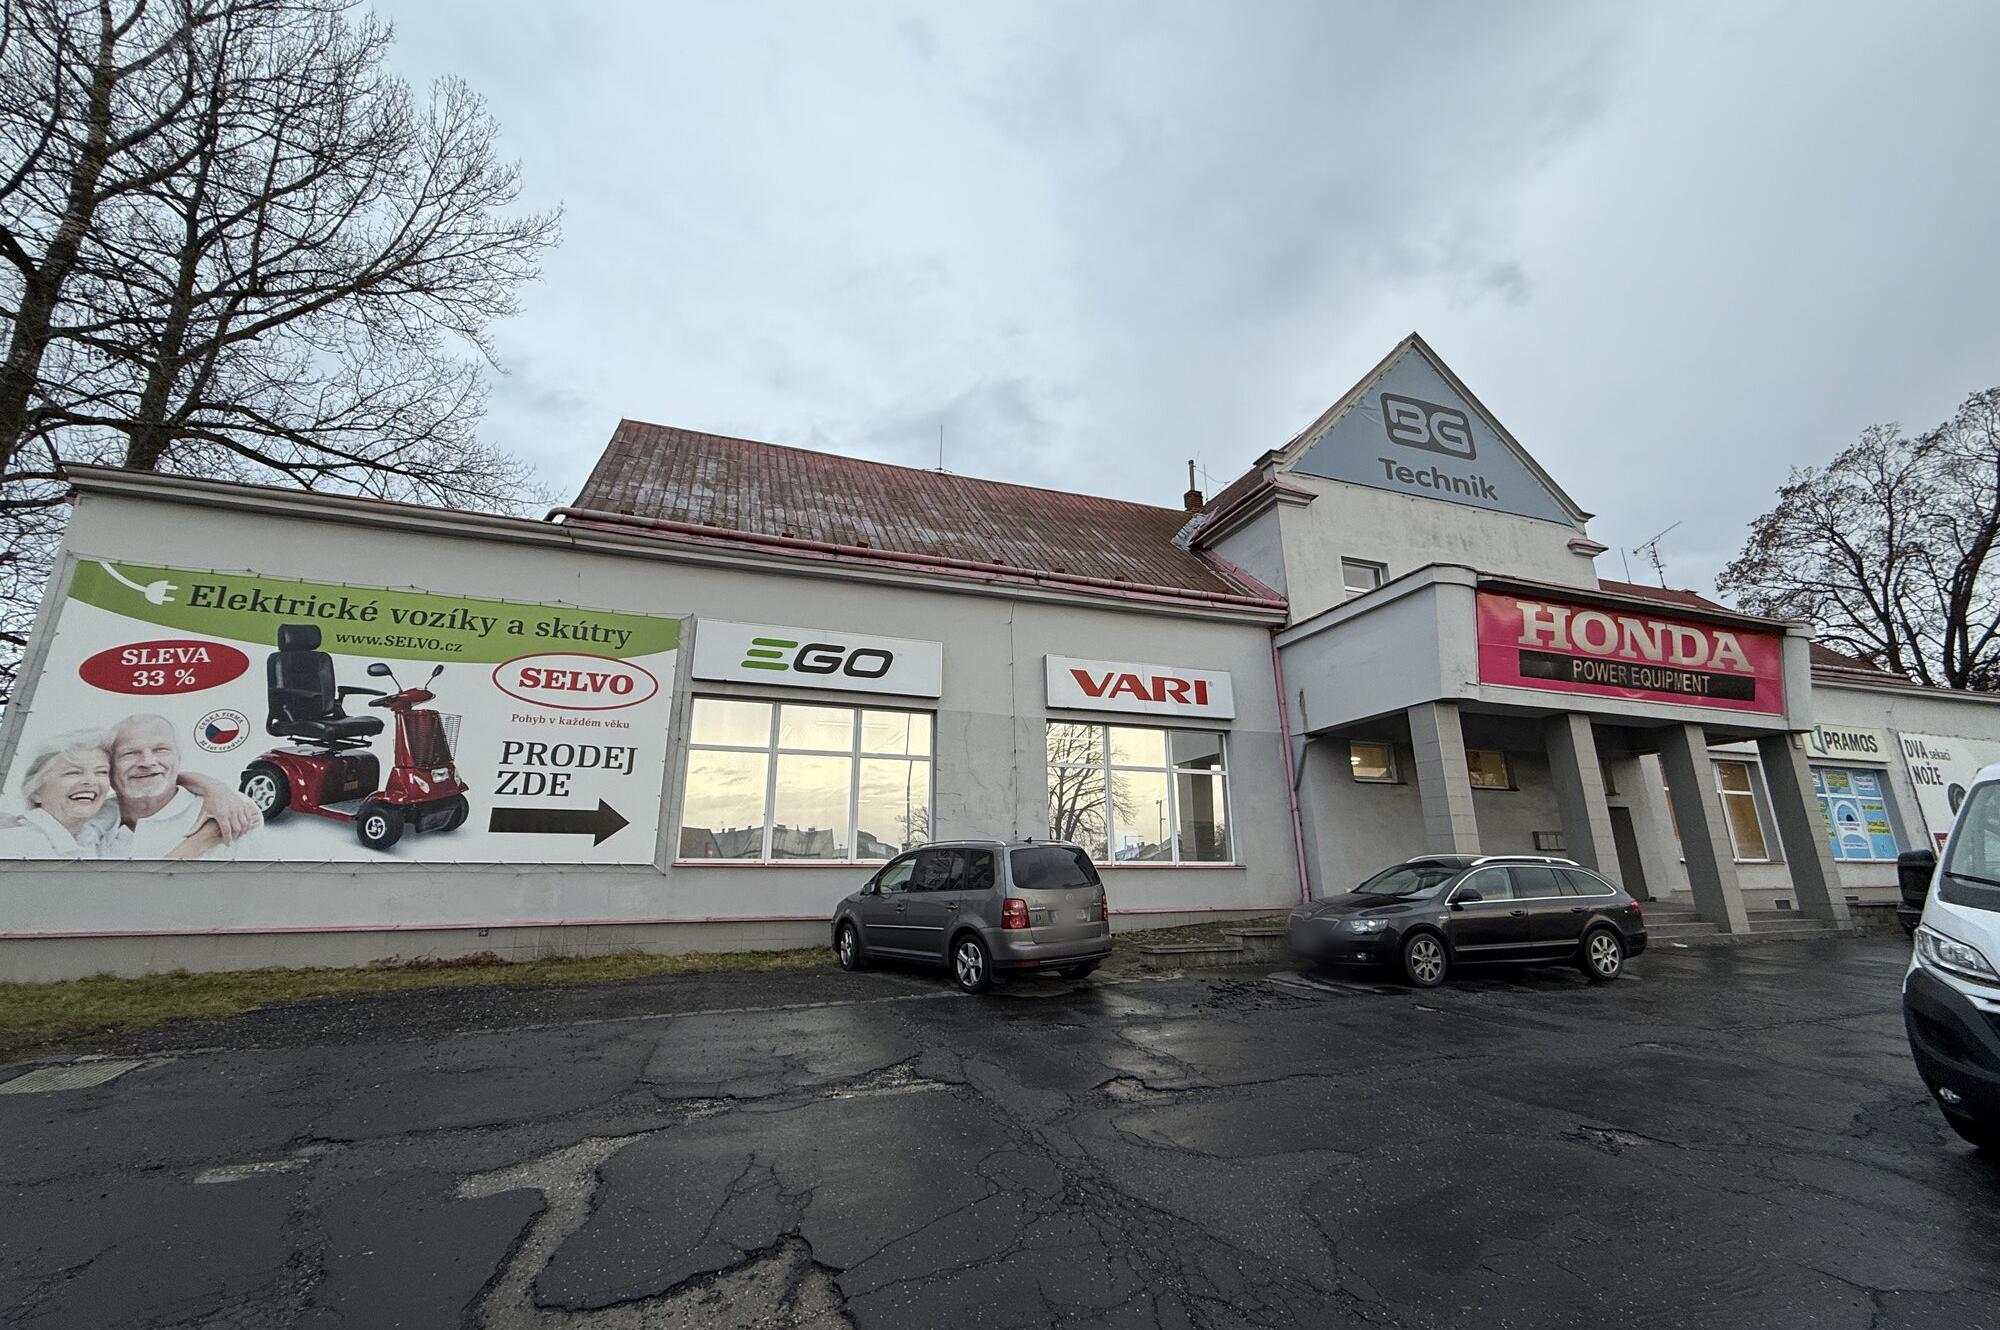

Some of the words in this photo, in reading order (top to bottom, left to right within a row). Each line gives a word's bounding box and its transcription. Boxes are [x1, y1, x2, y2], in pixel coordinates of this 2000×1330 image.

[1386, 399, 1472, 454] BG
[1378, 457, 1498, 501] Technik
[186, 584, 379, 622] Elektrické
[390, 607, 498, 638] vozíky
[507, 619, 525, 636] a
[535, 617, 633, 650] skútry
[335, 633, 463, 653] www.SELVO.cz
[1516, 601, 1755, 673] HONDA
[121, 647, 211, 666] SLEVA
[741, 637, 893, 679] EGO
[132, 670, 165, 687] 33
[175, 668, 195, 686] %
[518, 667, 634, 695] SELVO
[1070, 668, 1210, 705] VARI
[1572, 659, 1627, 684] POWER
[1632, 668, 1710, 693] EQUIPMENT
[511, 713, 546, 725] Pohyb
[549, 716, 556, 724] v
[558, 715, 601, 728] každém
[604, 719, 630, 729] věku
[1823, 731, 1879, 753] PRAMOS
[1903, 739, 1929, 759] DVA
[498, 741, 639, 775] PRODEJ
[494, 770, 572, 797] ZDE
[1911, 761, 1944, 786] NOŽE
